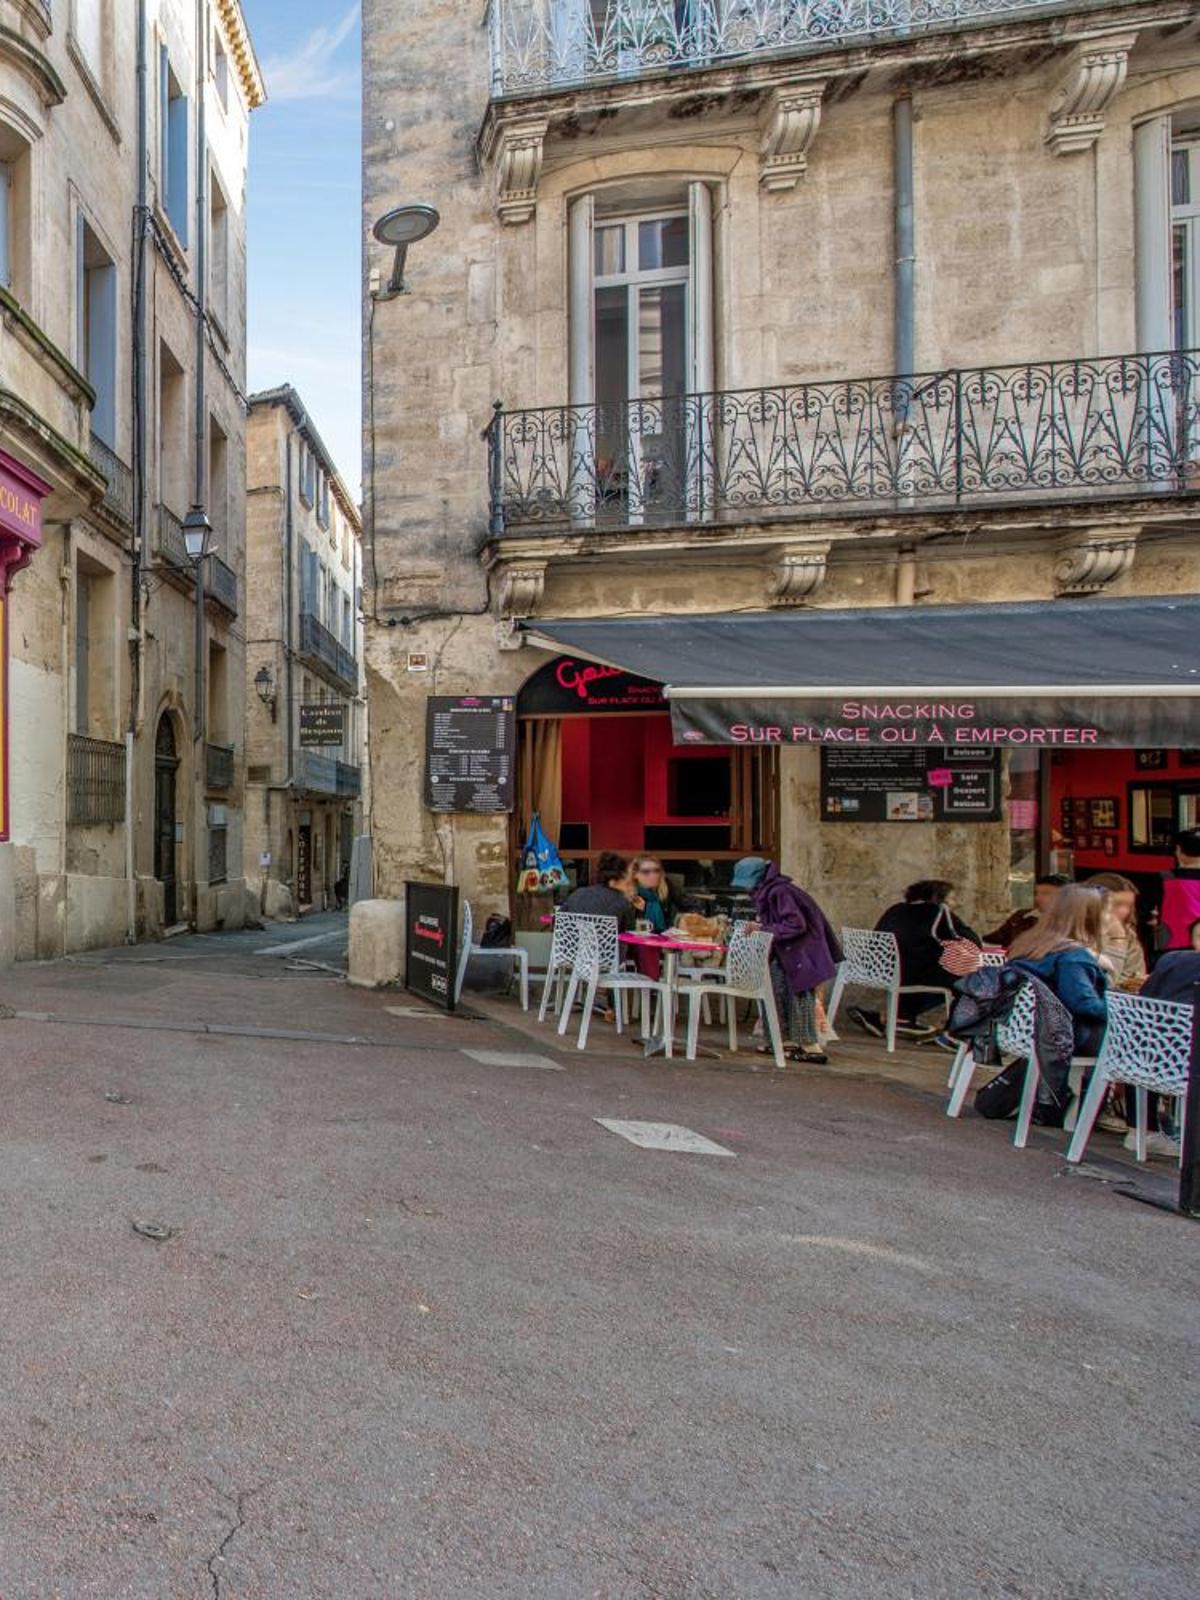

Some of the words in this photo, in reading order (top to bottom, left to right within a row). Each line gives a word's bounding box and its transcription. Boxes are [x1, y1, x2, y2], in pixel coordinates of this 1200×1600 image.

[842, 702, 975, 719] SNACKING
[730, 724, 782, 743] SUR
[792, 726, 870, 743] PLACE
[880, 727, 916, 743] OU
[928, 723, 945, 743] À
[955, 728, 1098, 744] EMPORTER
